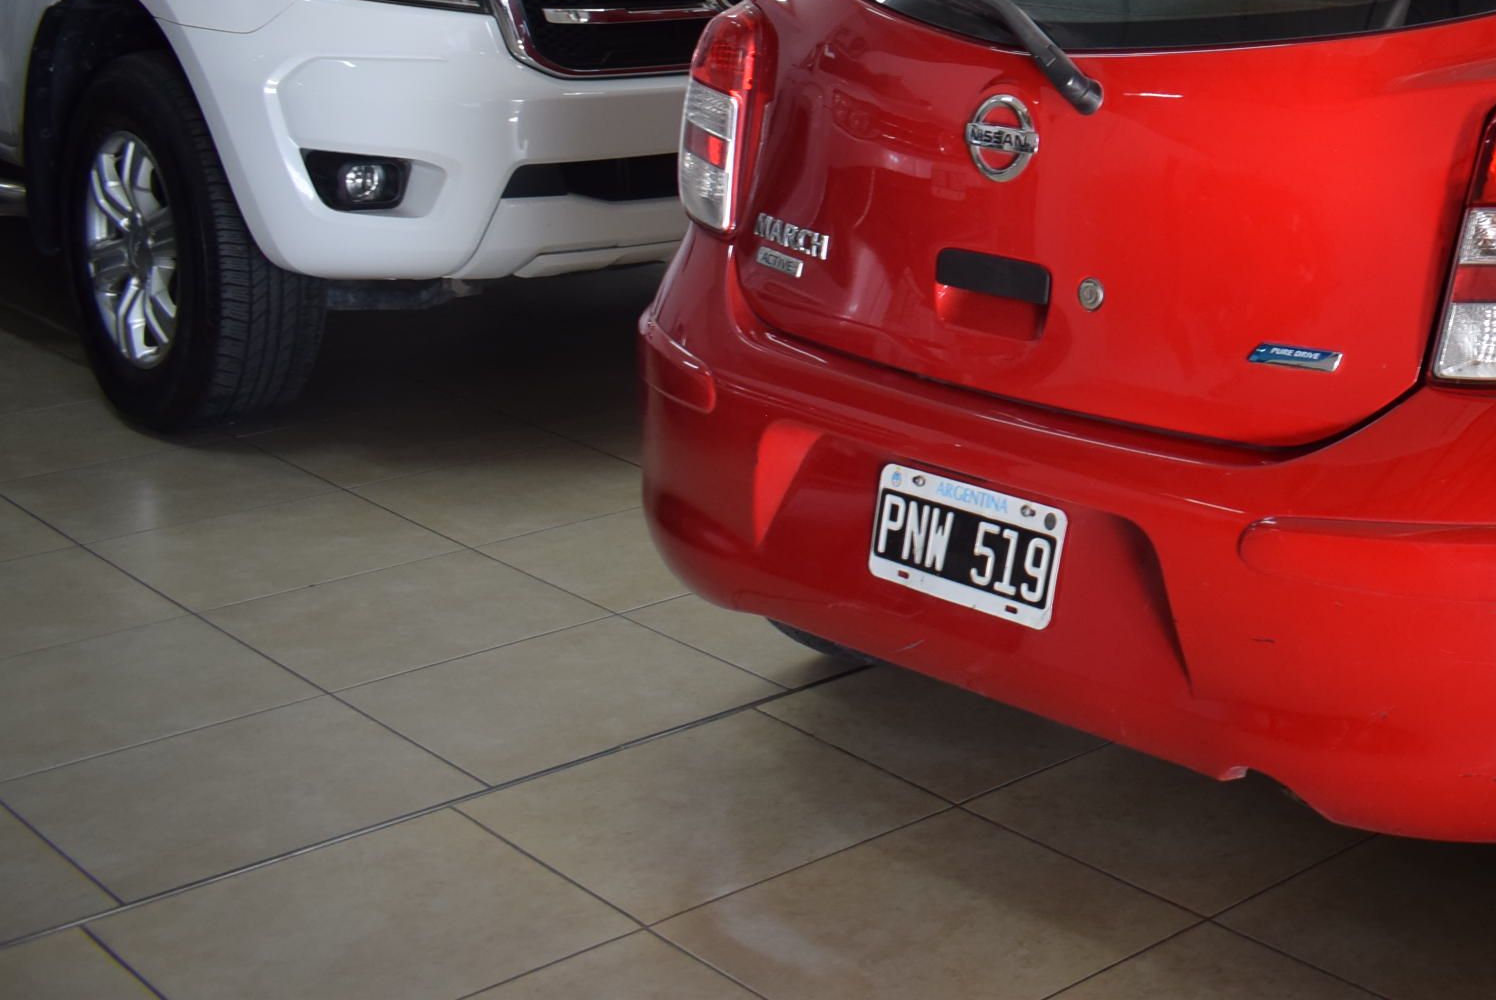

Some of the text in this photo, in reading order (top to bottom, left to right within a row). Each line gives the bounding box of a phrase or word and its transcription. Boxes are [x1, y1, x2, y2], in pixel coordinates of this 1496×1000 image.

[970, 127, 1031, 147] NISSAN
[754, 212, 830, 260] MARCH
[1270, 347, 1321, 360] PURE DRIVE
[936, 482, 1009, 513] ARGENTINA
[877, 493, 1051, 603] PNW 519
